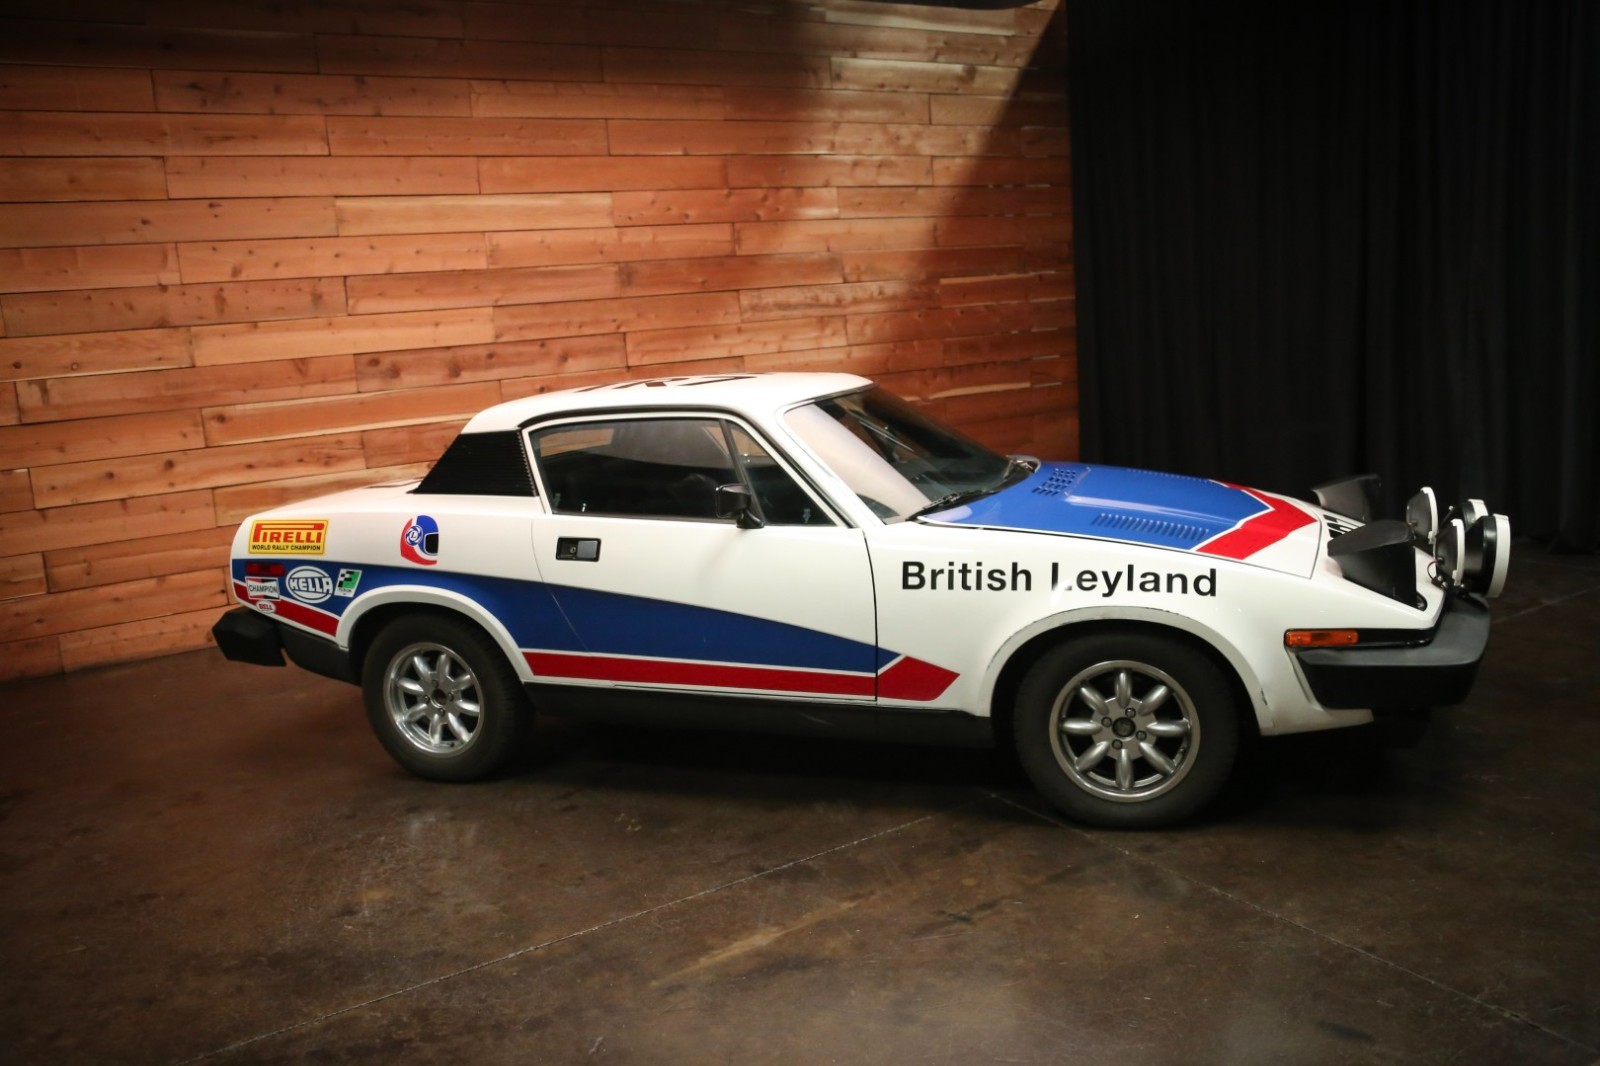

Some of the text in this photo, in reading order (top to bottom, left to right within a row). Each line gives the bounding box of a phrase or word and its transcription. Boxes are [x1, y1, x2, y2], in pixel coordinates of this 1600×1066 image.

[253, 523, 325, 543] PIRELLI
[289, 577, 333, 595] HELLA
[902, 561, 1217, 597] British Leyland
[248, 584, 279, 593] CHAMPION
[258, 603, 273, 611] BELL
